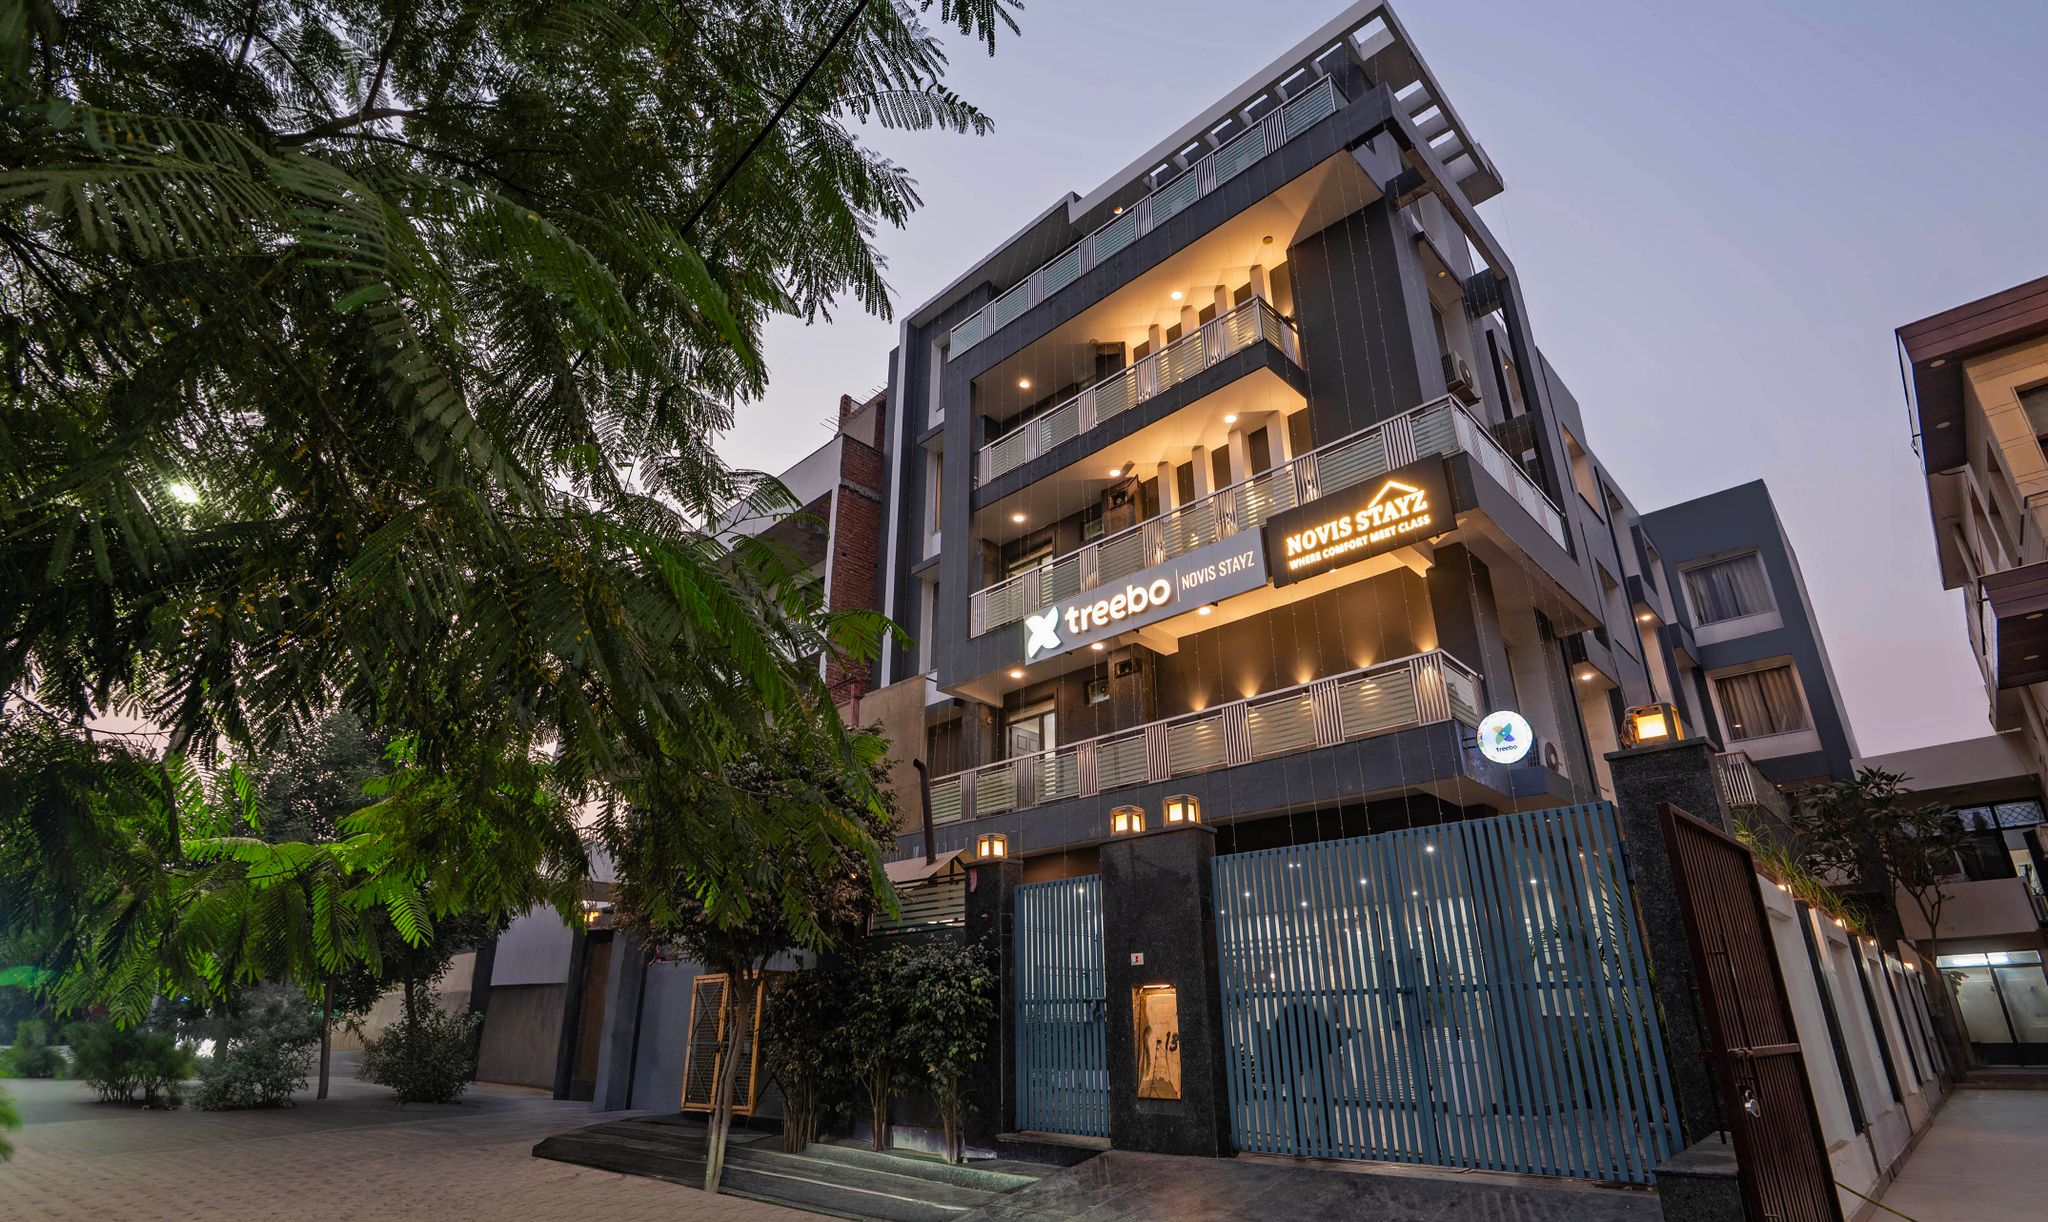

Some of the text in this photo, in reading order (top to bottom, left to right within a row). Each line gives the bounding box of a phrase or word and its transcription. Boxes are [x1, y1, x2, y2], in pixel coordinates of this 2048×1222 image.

[1286, 489, 1428, 557] NOVIS STAYZ
[1289, 514, 1431, 570] WHERE COMFORT MEET CLASS
[1064, 550, 1255, 634] treebo NOVIS STAYZ
[1496, 744, 1518, 752] treebo
